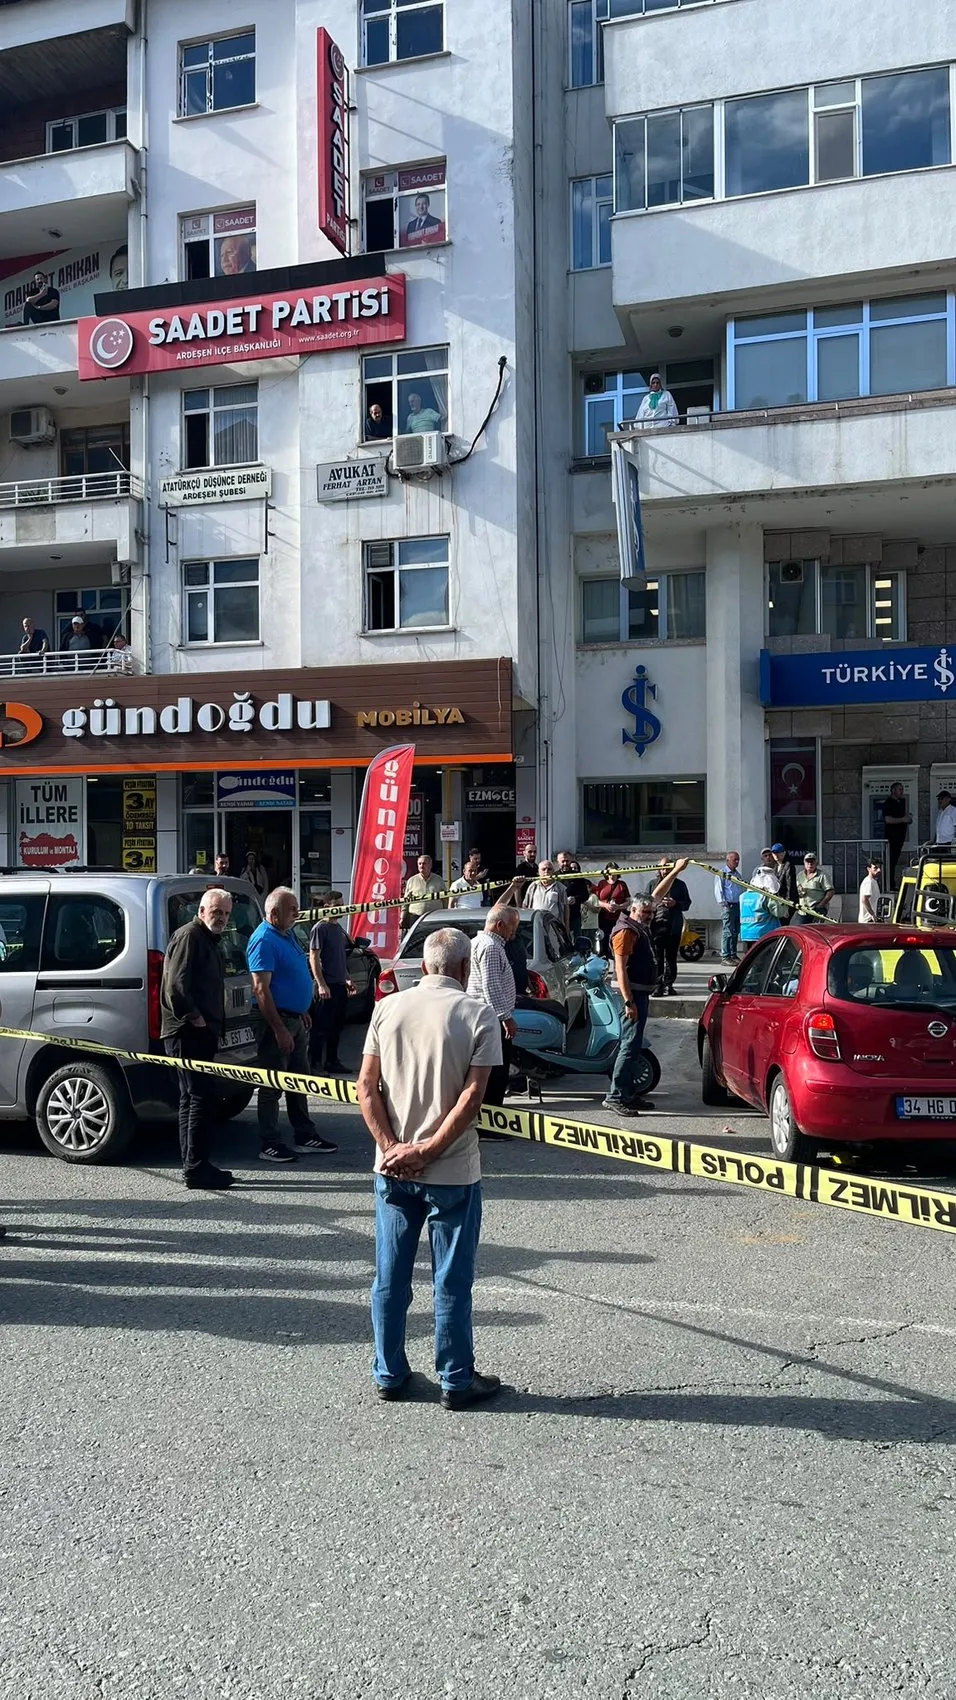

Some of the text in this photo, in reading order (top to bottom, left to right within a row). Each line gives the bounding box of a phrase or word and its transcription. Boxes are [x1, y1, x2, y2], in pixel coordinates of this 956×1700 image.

[331, 81, 345, 219] SAADET
[411, 172, 444, 184] SAADET
[225, 215, 255, 227] SAADET
[58, 252, 100, 287] ARIKAN
[148, 304, 263, 345] SAADET
[176, 329, 361, 361] ARDEŞEN İLÇE BAŞKANLIĞI www.saadet.org.tr
[328, 463, 376, 481] AVUKAT
[162, 471, 268, 493] ATATÜRKÇÜ DÜŞÜNCE DERNEĞİ
[322, 476, 383, 491] FERHAT ARTAN
[182, 486, 246, 501] ARDEŞEN ŞUBESİ
[821, 660, 928, 685] TÜRKİYE
[61, 691, 466, 738] gündoğdu MOBİLYA
[30, 781, 67, 803] TÜM
[125, 792, 155, 810] 3 AY
[20, 802, 78, 824] İLLERE
[125, 821, 133, 830] 10
[23, 845, 49, 855] KURULUM
[54, 845, 76, 855] MONTAJ
[124, 850, 154, 869] 3 AY
[230, 1031, 242, 1045] EST
[904, 1099, 921, 1114] 34
[927, 1099, 944, 1114] HG
[283, 1075, 331, 1097] POLİS
[477, 1107, 523, 1132] POLİ
[550, 1121, 662, 1162] GİRİLMEZ
[701, 1152, 785, 1190] POLİS
[828, 1177, 956, 1227] RİLMEZ
